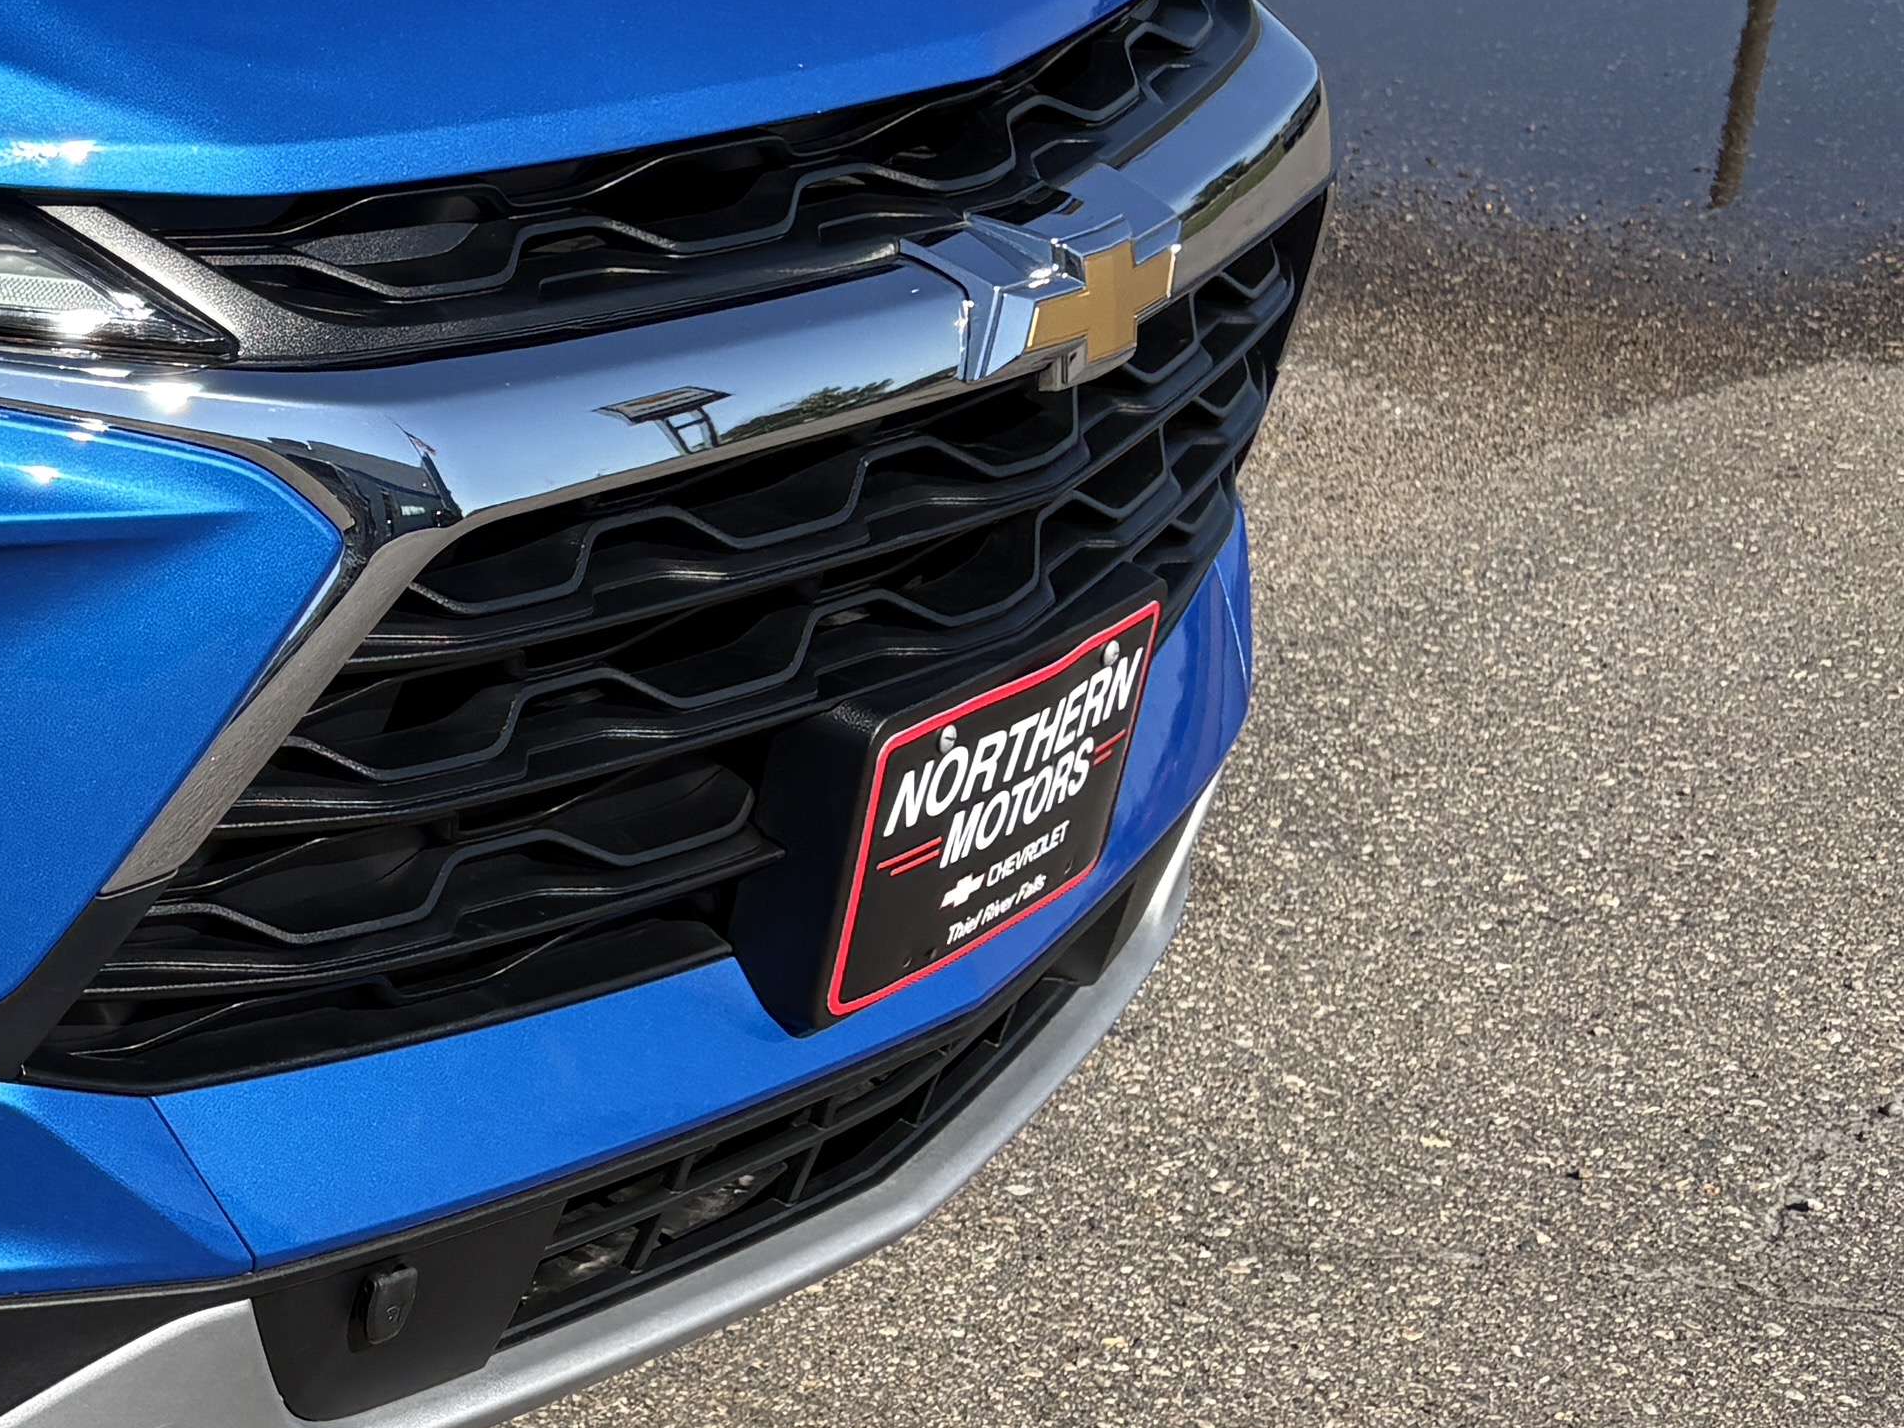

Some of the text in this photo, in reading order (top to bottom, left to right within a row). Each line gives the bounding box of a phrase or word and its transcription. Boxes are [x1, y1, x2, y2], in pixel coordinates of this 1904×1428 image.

[882, 646, 1145, 838] NORTHERN
[939, 736, 1095, 869] MOTORS
[986, 819, 1071, 888] CHEVROLET
[946, 873, 1047, 946] Thief River Falls
